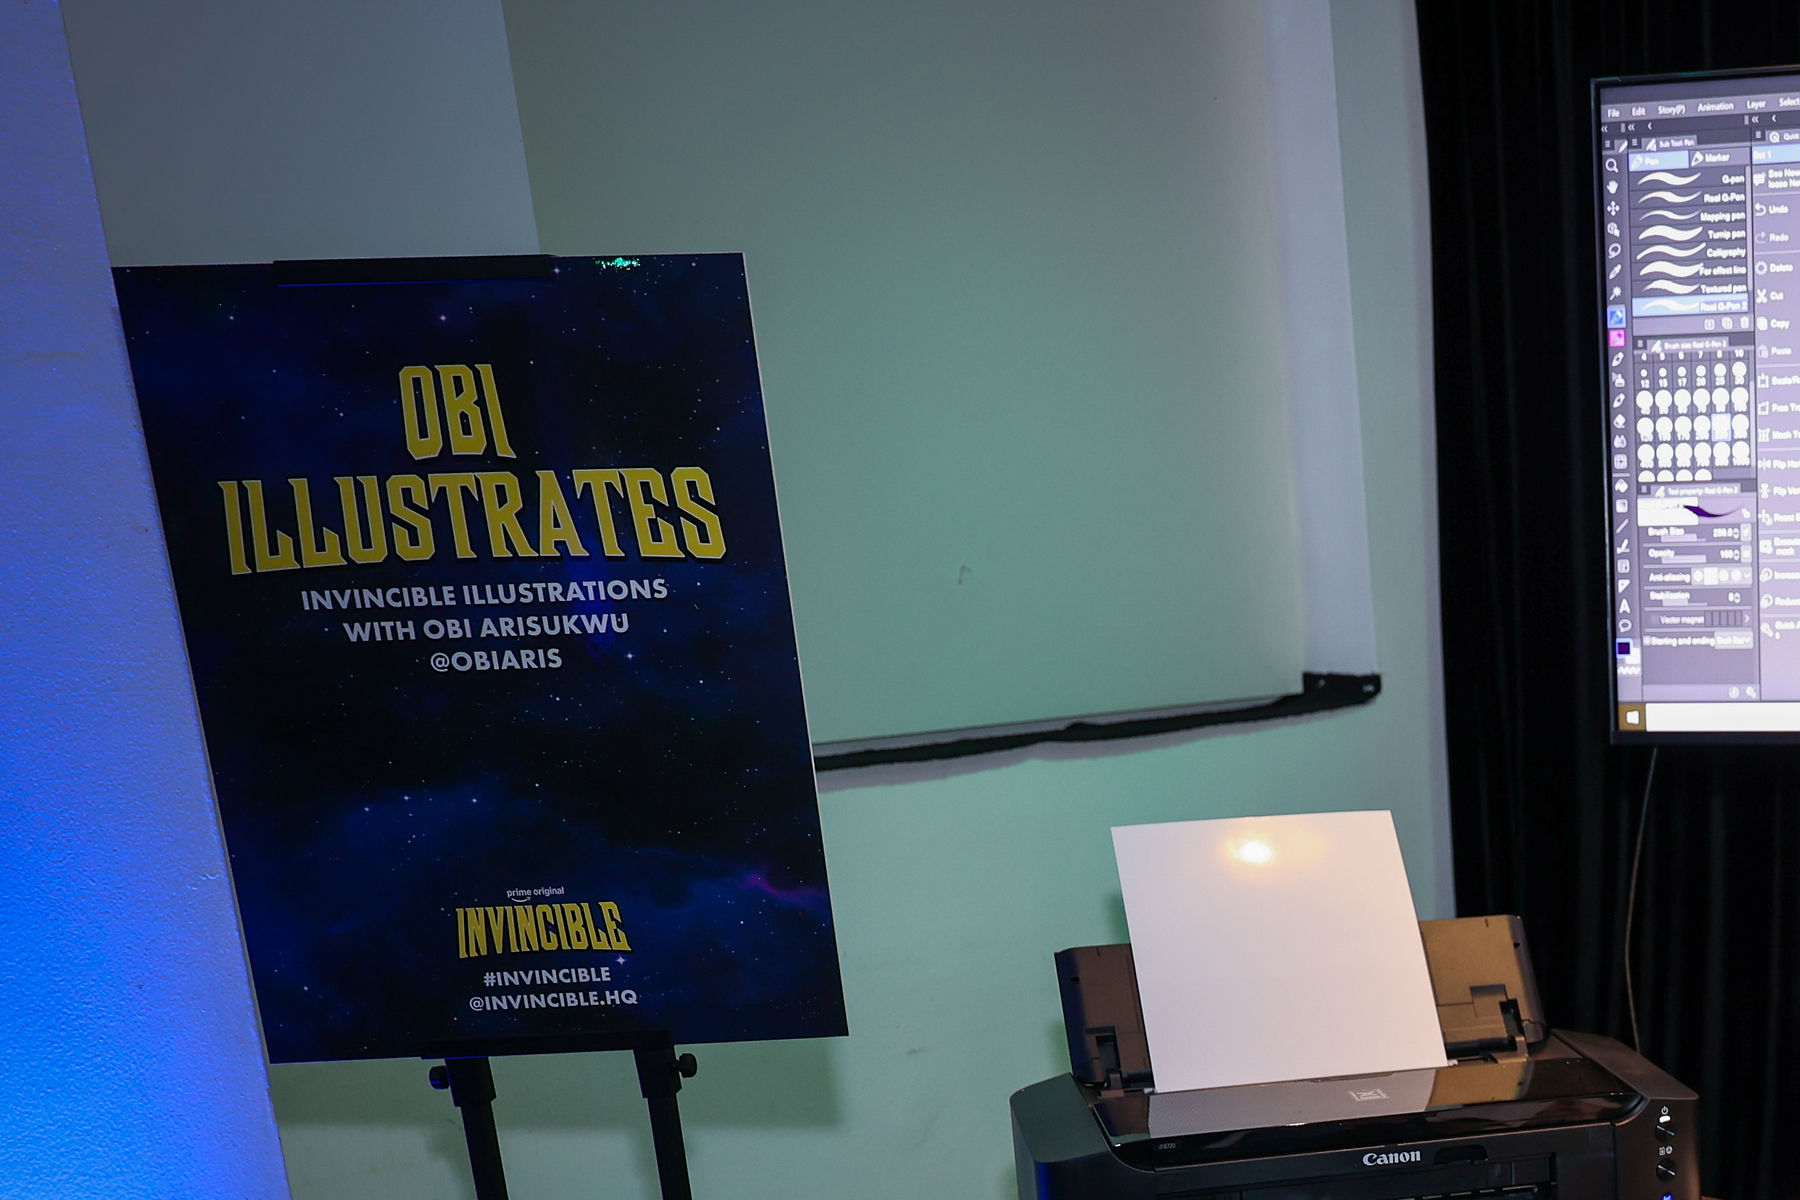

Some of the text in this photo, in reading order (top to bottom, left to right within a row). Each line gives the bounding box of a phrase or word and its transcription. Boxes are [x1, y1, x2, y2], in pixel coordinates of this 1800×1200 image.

[1608, 108, 1620, 118] File
[1632, 106, 1646, 116] Edit
[1658, 104, 1686, 115] Story(P)
[1698, 102, 1734, 112] Animation
[1746, 100, 1766, 110] Layer
[1779, 97, 1800, 106] Select
[1769, 204, 1789, 214] Undo
[1770, 234, 1789, 242] Redo
[1770, 291, 1784, 300] Cut
[1771, 319, 1790, 330] Copy
[399, 363, 516, 460] OBI
[217, 466, 727, 576] ILLUSTRATES
[301, 578, 668, 611] INVINCIBLE ILLUSTRATIONS
[343, 612, 630, 642] WITH OBI ARISUKWU
[430, 648, 563, 674] @OBIARIS
[506, 886, 565, 898] prime original
[456, 901, 632, 959] INVINCIBLE
[483, 966, 612, 987] #INVINCIBLE
[469, 989, 638, 1012] @INVINCIBLE.HQ
[1362, 1150, 1421, 1166] Canon
